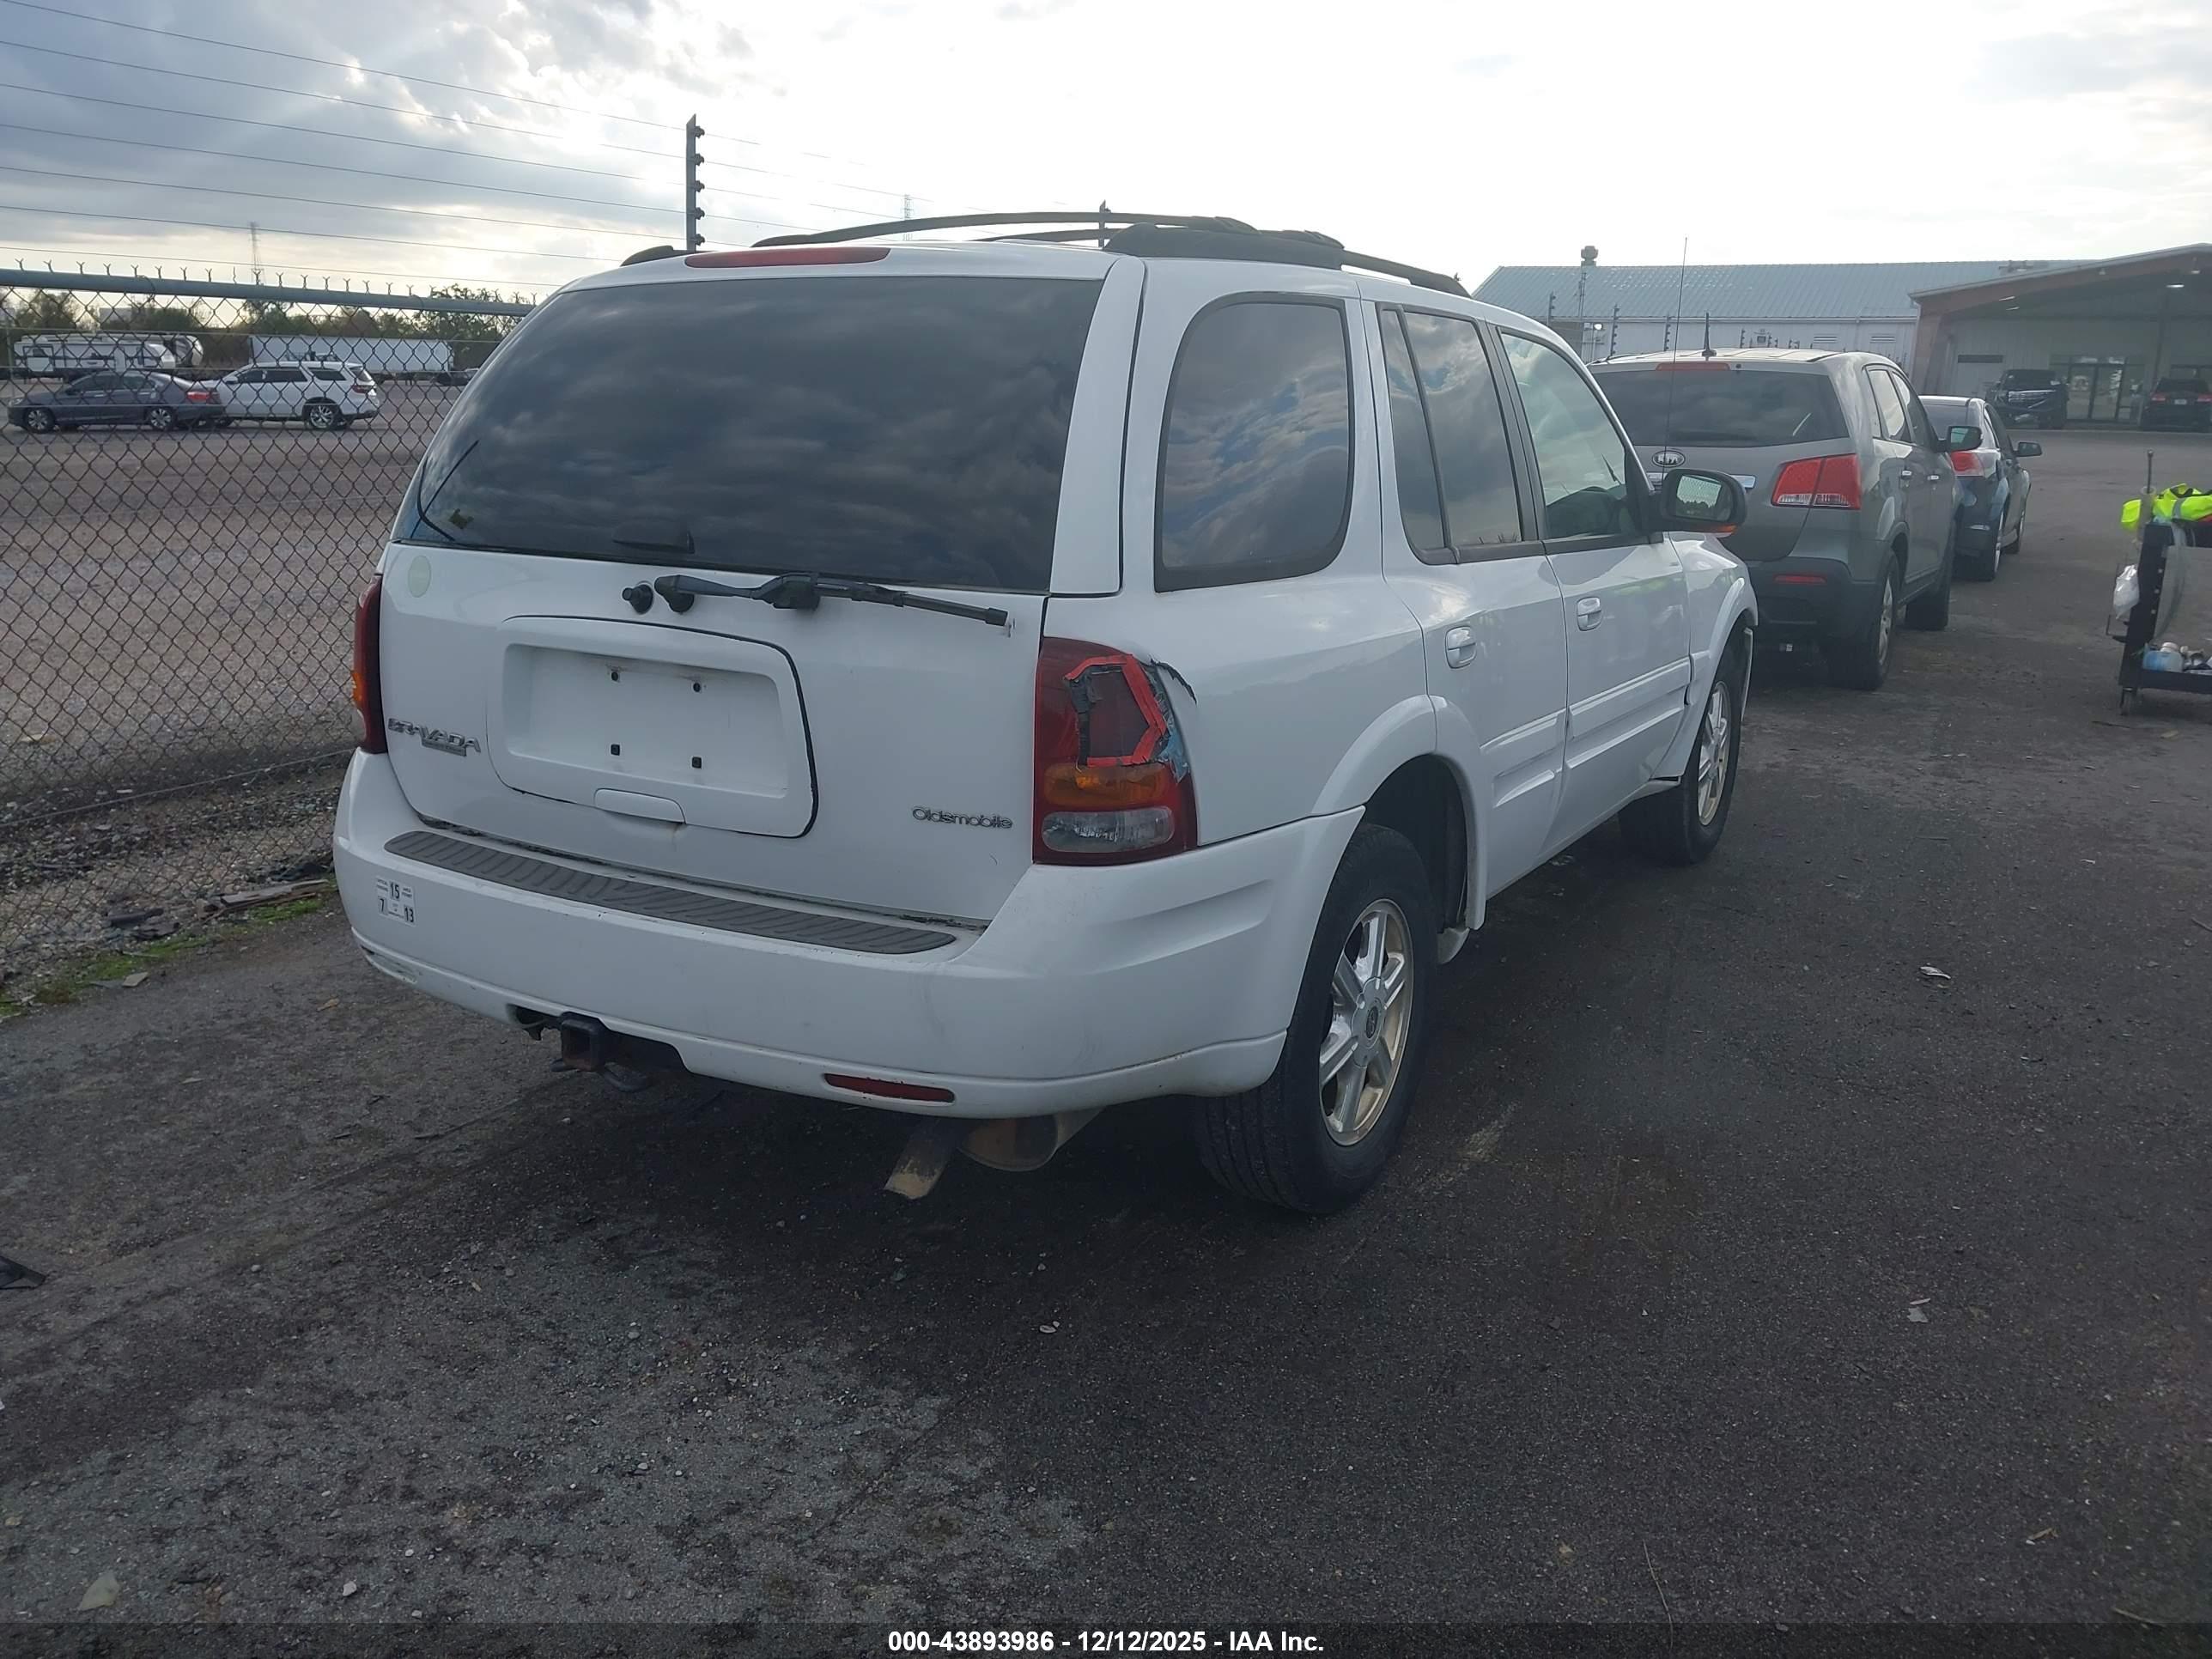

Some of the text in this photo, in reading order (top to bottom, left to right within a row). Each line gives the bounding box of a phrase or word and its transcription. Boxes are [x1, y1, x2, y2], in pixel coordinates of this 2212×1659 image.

[912, 806, 1013, 829] Oldsmobile
[390, 883, 399, 899] 15
[404, 907, 414, 923] 13
